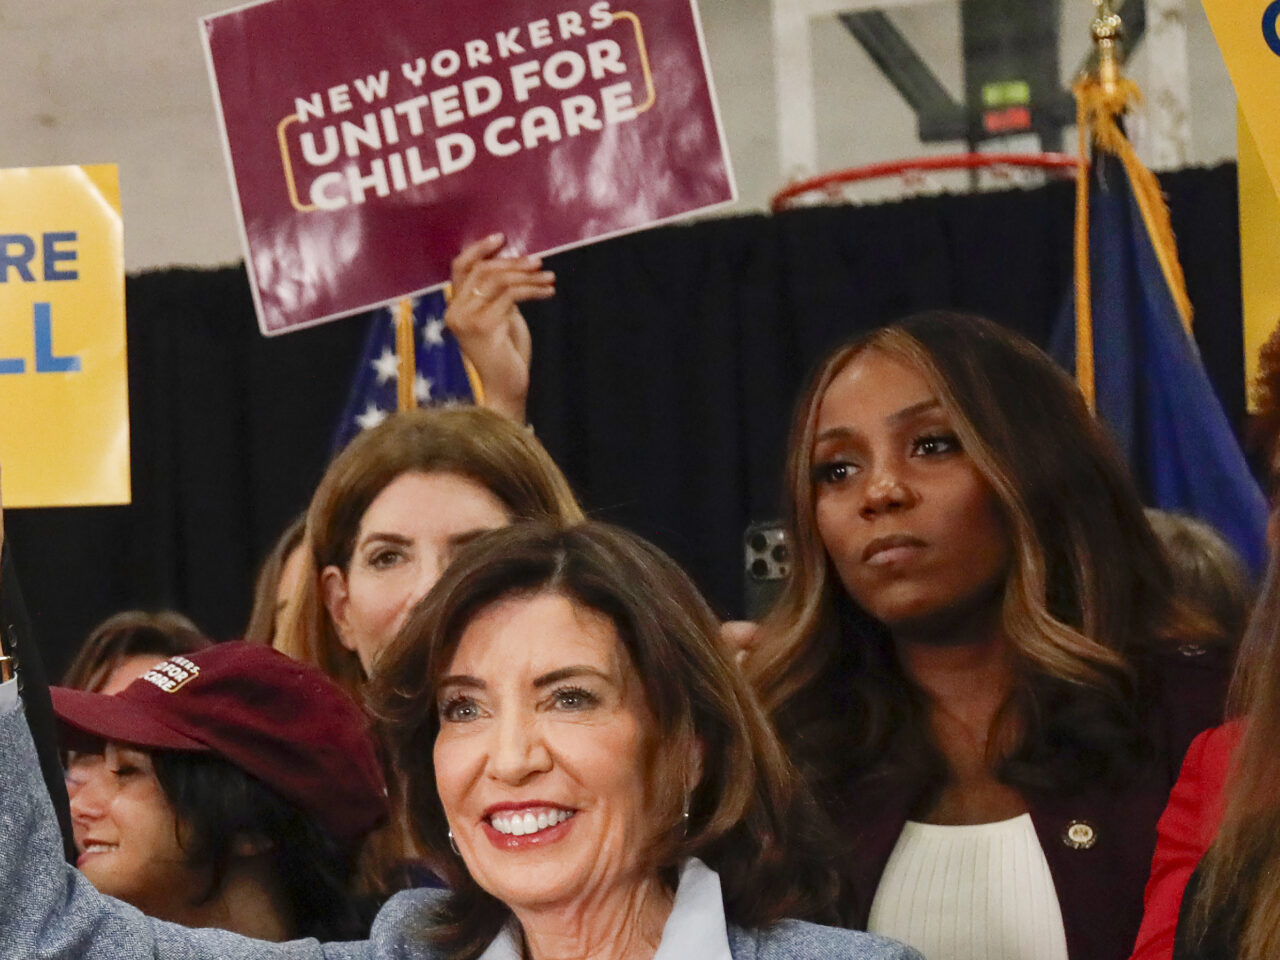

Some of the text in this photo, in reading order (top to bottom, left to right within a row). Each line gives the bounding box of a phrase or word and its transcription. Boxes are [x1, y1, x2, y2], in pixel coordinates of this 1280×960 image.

[294, 1, 614, 123] NEW YORKERS
[299, 38, 628, 166] UNITED FOR
[309, 81, 638, 211] CHILD CARE
